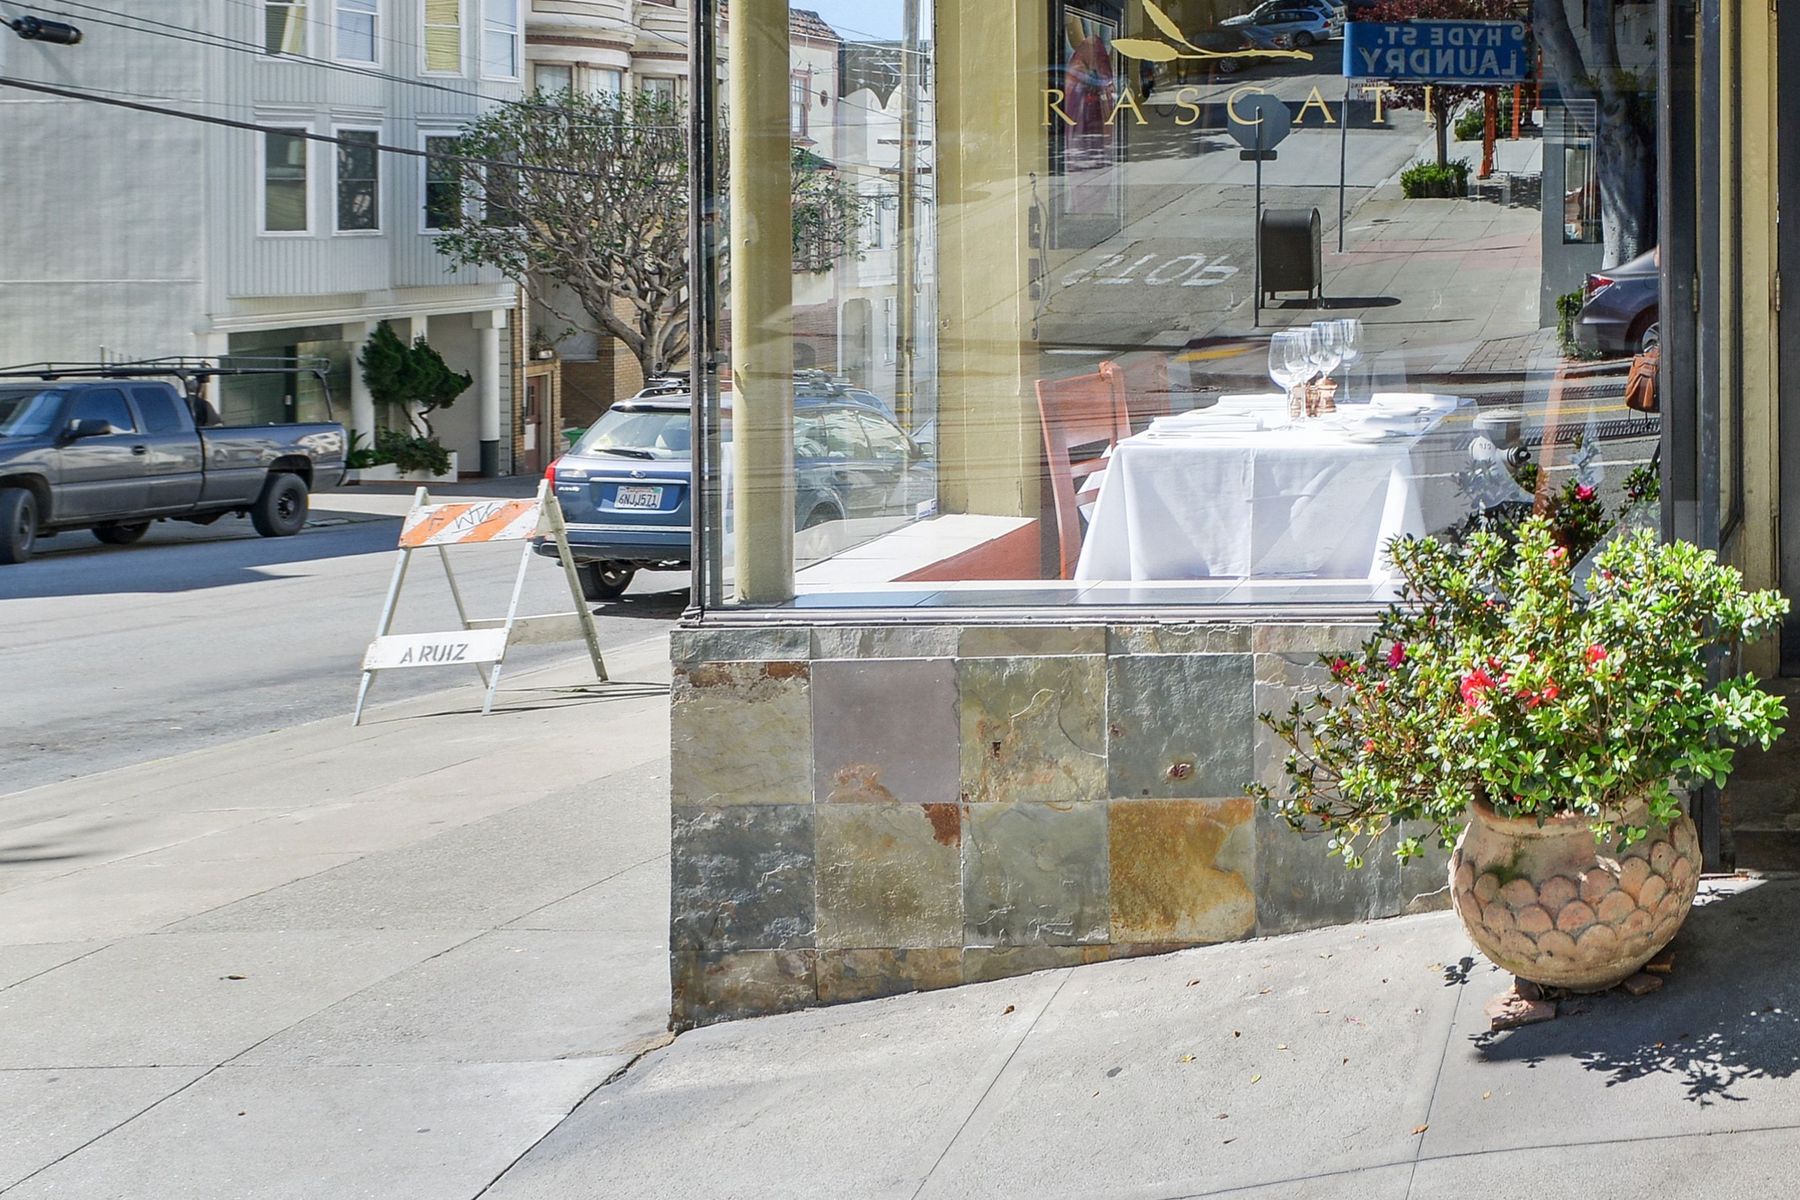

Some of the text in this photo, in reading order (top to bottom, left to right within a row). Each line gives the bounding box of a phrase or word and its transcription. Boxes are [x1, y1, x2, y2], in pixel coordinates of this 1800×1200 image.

[618, 493, 658, 508] 6NJJ571
[399, 643, 469, 664] A RUIZ
